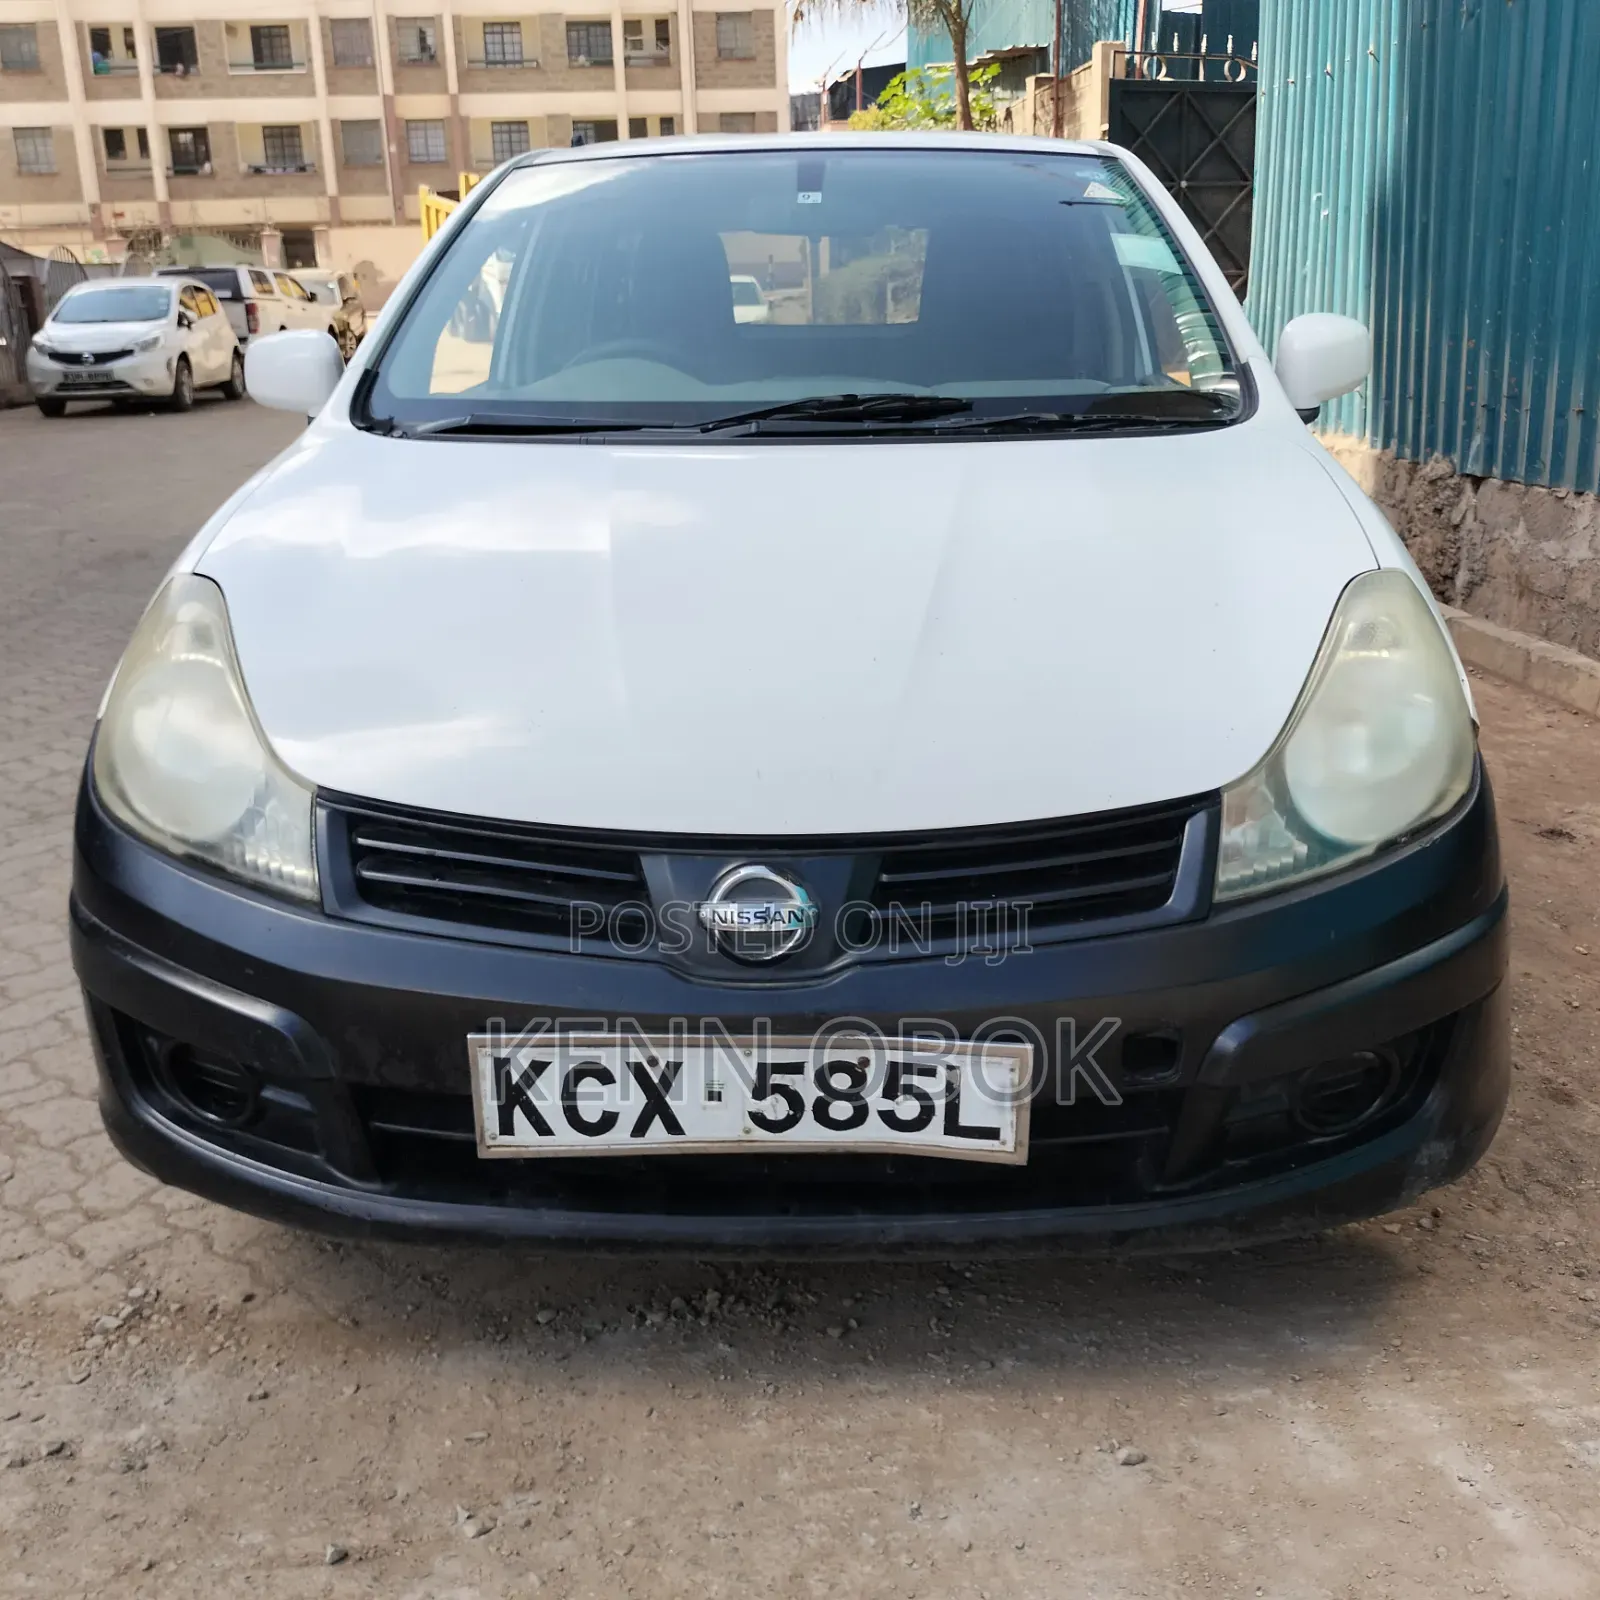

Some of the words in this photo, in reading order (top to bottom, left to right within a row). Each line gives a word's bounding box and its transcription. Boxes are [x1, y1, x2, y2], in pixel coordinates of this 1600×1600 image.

[712, 906, 805, 925] NISSAN
[493, 1056, 687, 1138] KCX
[747, 1060, 1001, 1141] 585L
